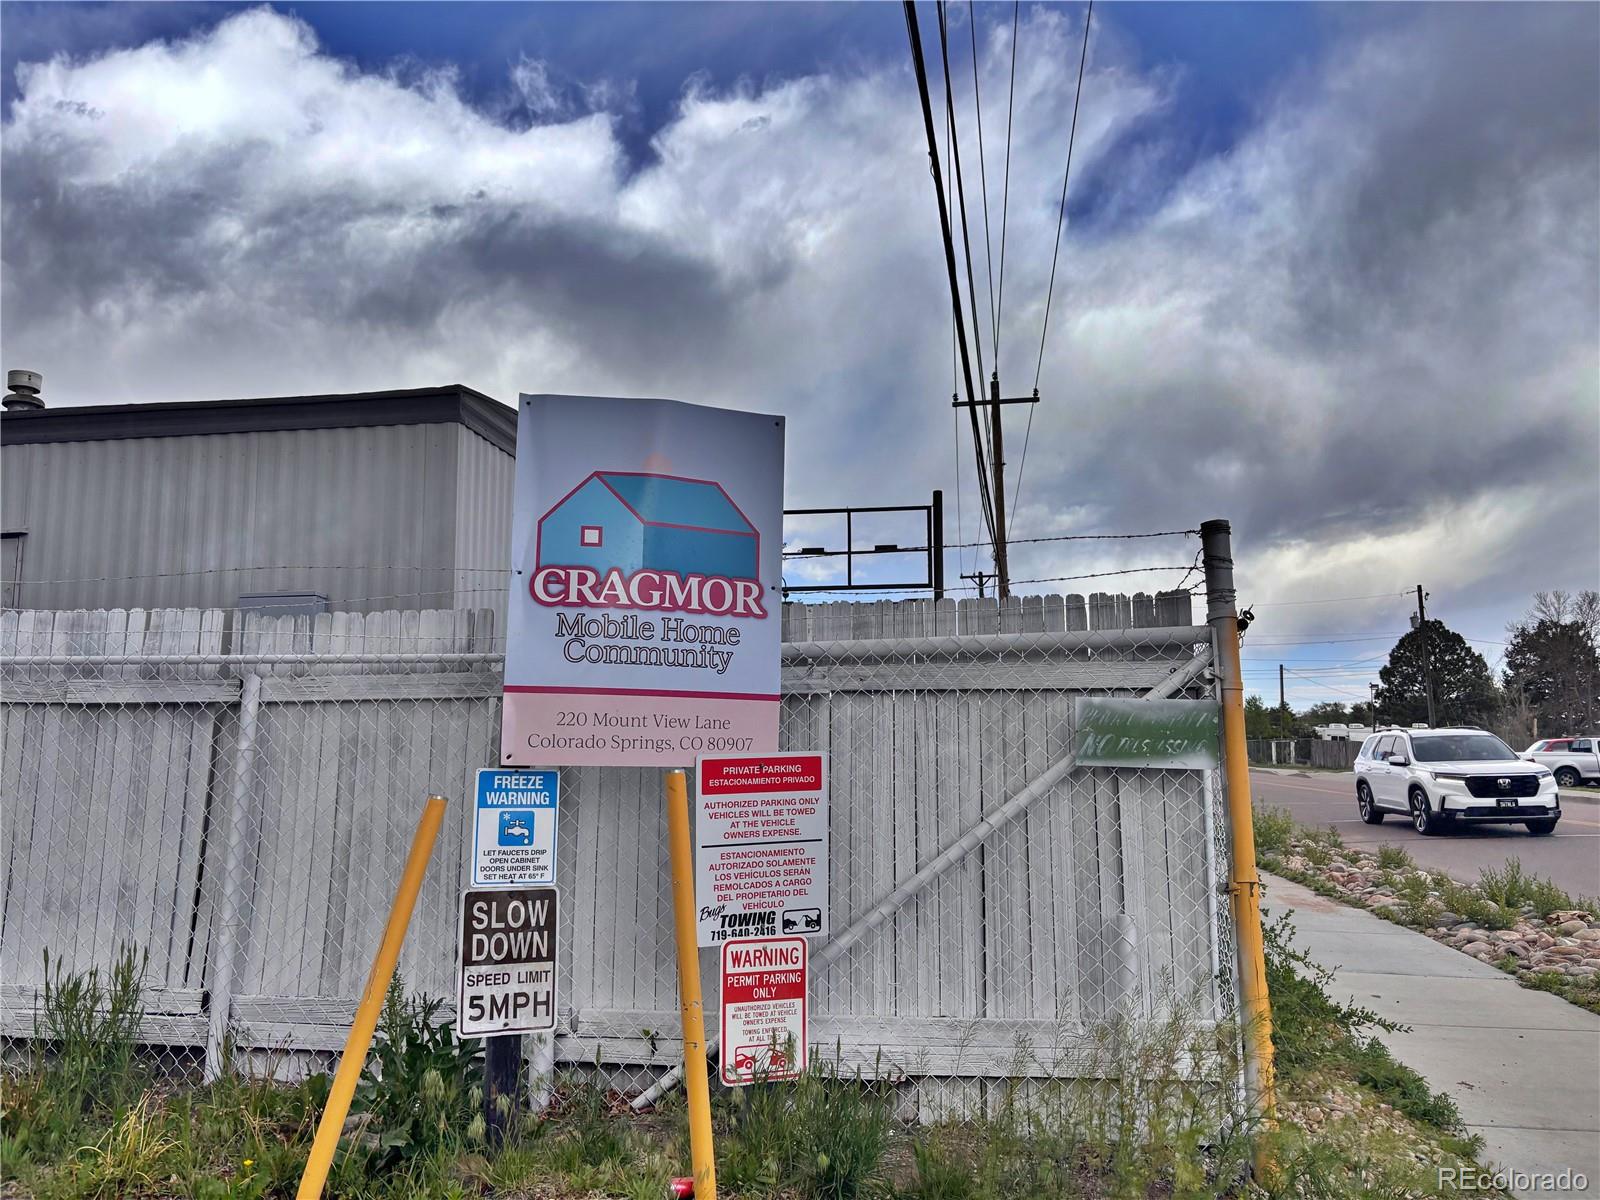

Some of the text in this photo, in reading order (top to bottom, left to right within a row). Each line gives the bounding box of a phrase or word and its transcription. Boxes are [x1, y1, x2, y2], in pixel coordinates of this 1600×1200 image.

[533, 568, 763, 615] CRAGMOR
[555, 613, 741, 645] Mobile Home
[563, 638, 734, 674] Community
[556, 712, 730, 729] 220 Mount View Lane
[527, 733, 753, 752] Colorado Springs, CO 80907
[723, 765, 801, 775] PRIVATE PARKING
[494, 776, 543, 788] FREEZE
[709, 777, 780, 786] ESTACIONAMIENTO
[486, 792, 549, 804] WARNING
[704, 801, 758, 809] AUTHORIZED
[761, 799, 796, 807] PARKING
[709, 811, 749, 819] VEHICLES
[743, 820, 758, 828] THE
[761, 819, 795, 827] VEHICLE
[724, 829, 801, 839] OWNERS EXPENSE.
[720, 848, 805, 860] ESTANCIONAMIENTO
[709, 858, 816, 871] AUTORIZADO SOLAMENTE
[714, 881, 773, 892] REMOLCADOS
[783, 878, 812, 886] CARGO
[736, 890, 790, 900] PROPIETARIO
[472, 900, 549, 929] SLOW
[721, 911, 776, 928] TOWING
[472, 931, 548, 961] DOWN
[731, 947, 799, 968] WARNING
[467, 971, 550, 987] SPEED LIMIT
[728, 972, 801, 987] PERMIT PARKING
[753, 987, 776, 998] ONLY
